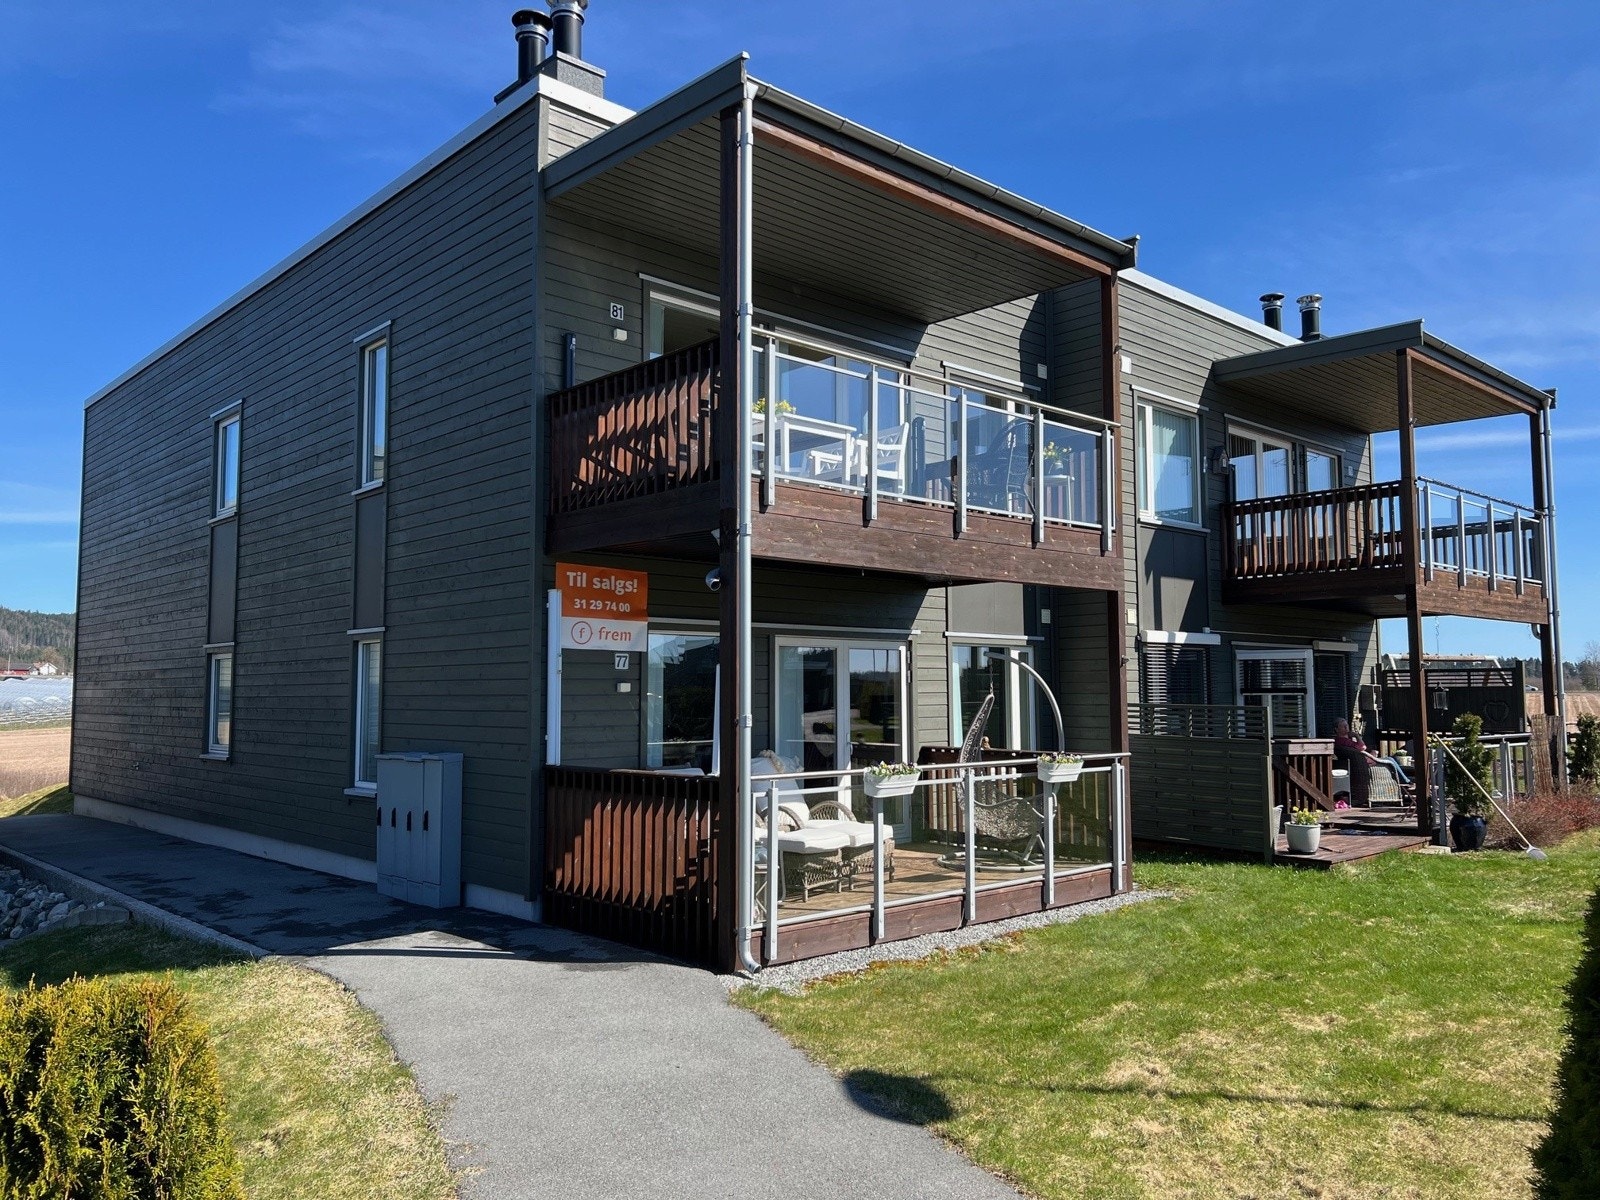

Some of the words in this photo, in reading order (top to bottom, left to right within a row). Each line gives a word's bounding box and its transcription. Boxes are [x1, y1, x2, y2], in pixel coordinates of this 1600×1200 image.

[612, 305, 622, 318] 81
[566, 571, 586, 588] Til
[592, 576, 638, 595] salgs!
[574, 598, 586, 610] 31
[590, 600, 602, 610] 29
[605, 602, 617, 611] 74
[619, 603, 630, 612] 00
[598, 626, 632, 642] frem
[616, 656, 628, 668] 77
